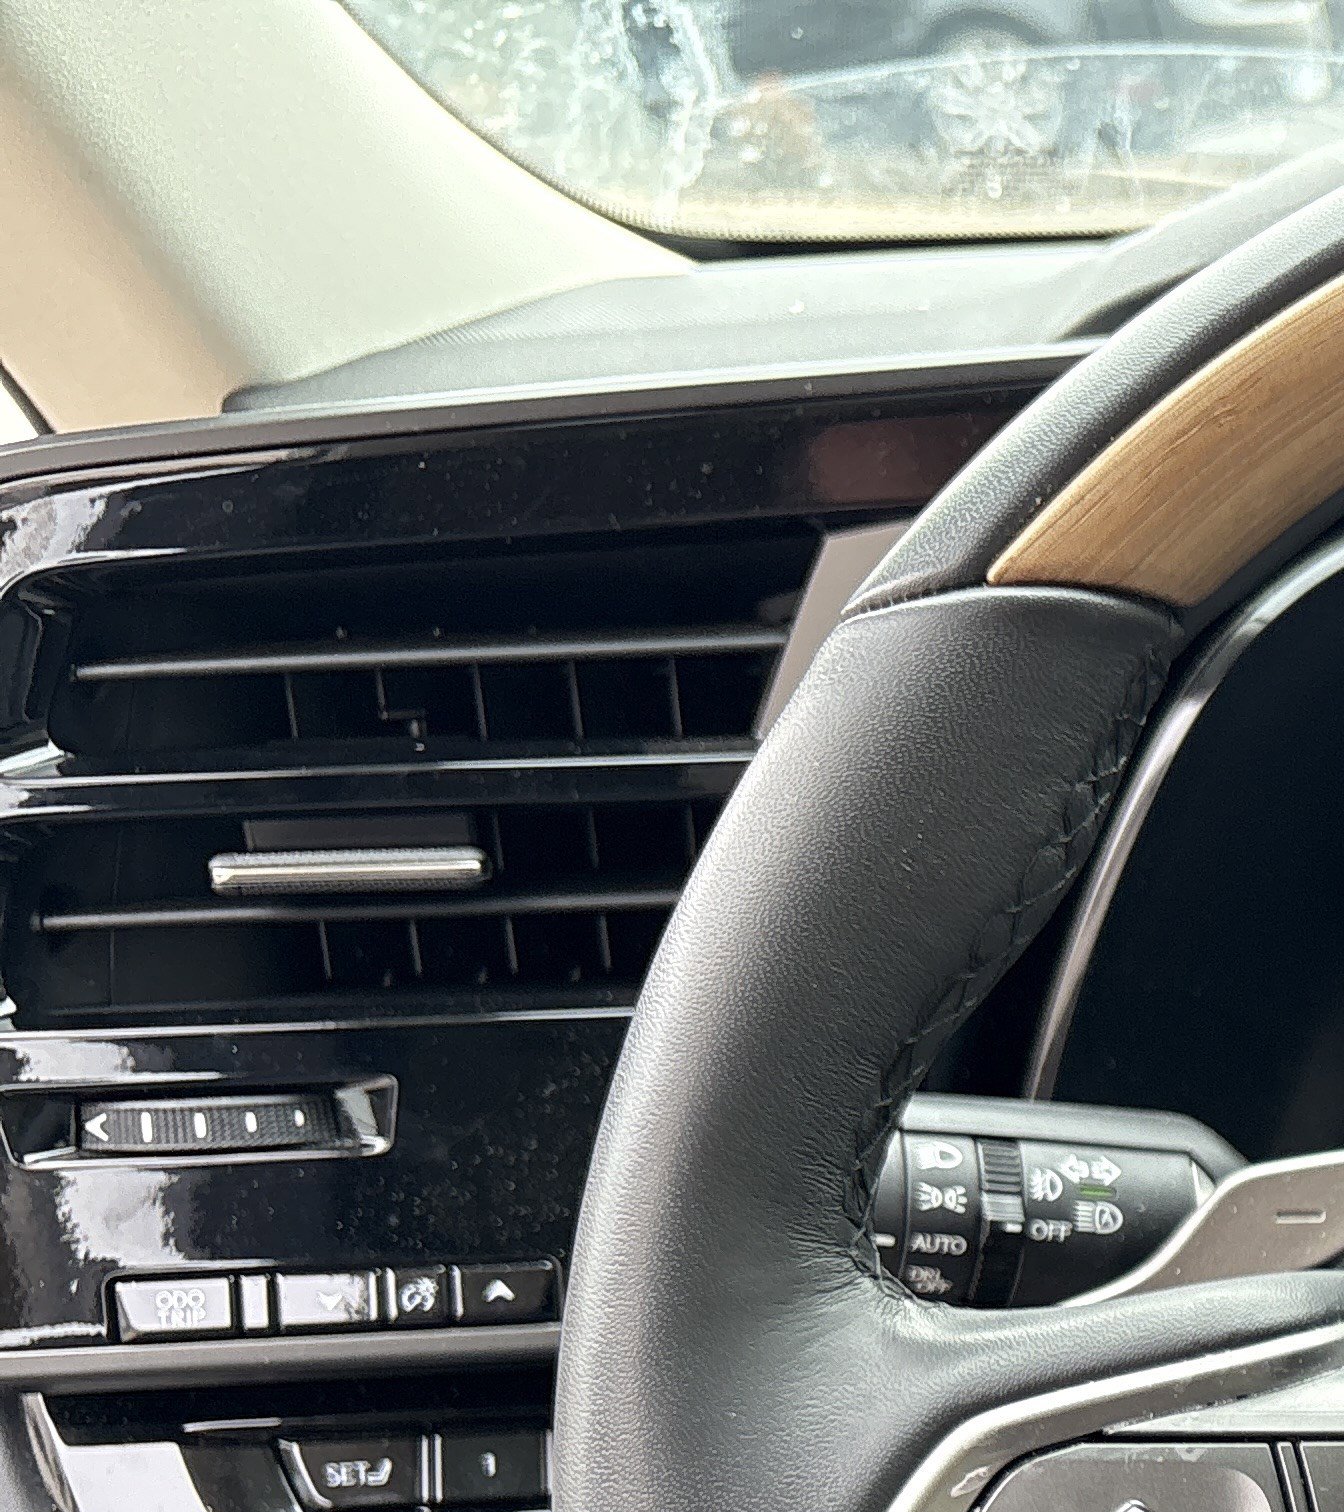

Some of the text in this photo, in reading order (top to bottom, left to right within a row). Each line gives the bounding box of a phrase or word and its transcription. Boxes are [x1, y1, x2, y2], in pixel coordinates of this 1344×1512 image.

[1029, 1218, 1073, 1243] OFF
[910, 1231, 967, 1256] AUTO
[156, 1288, 206, 1311] ODO
[323, 1460, 371, 1487] SET
